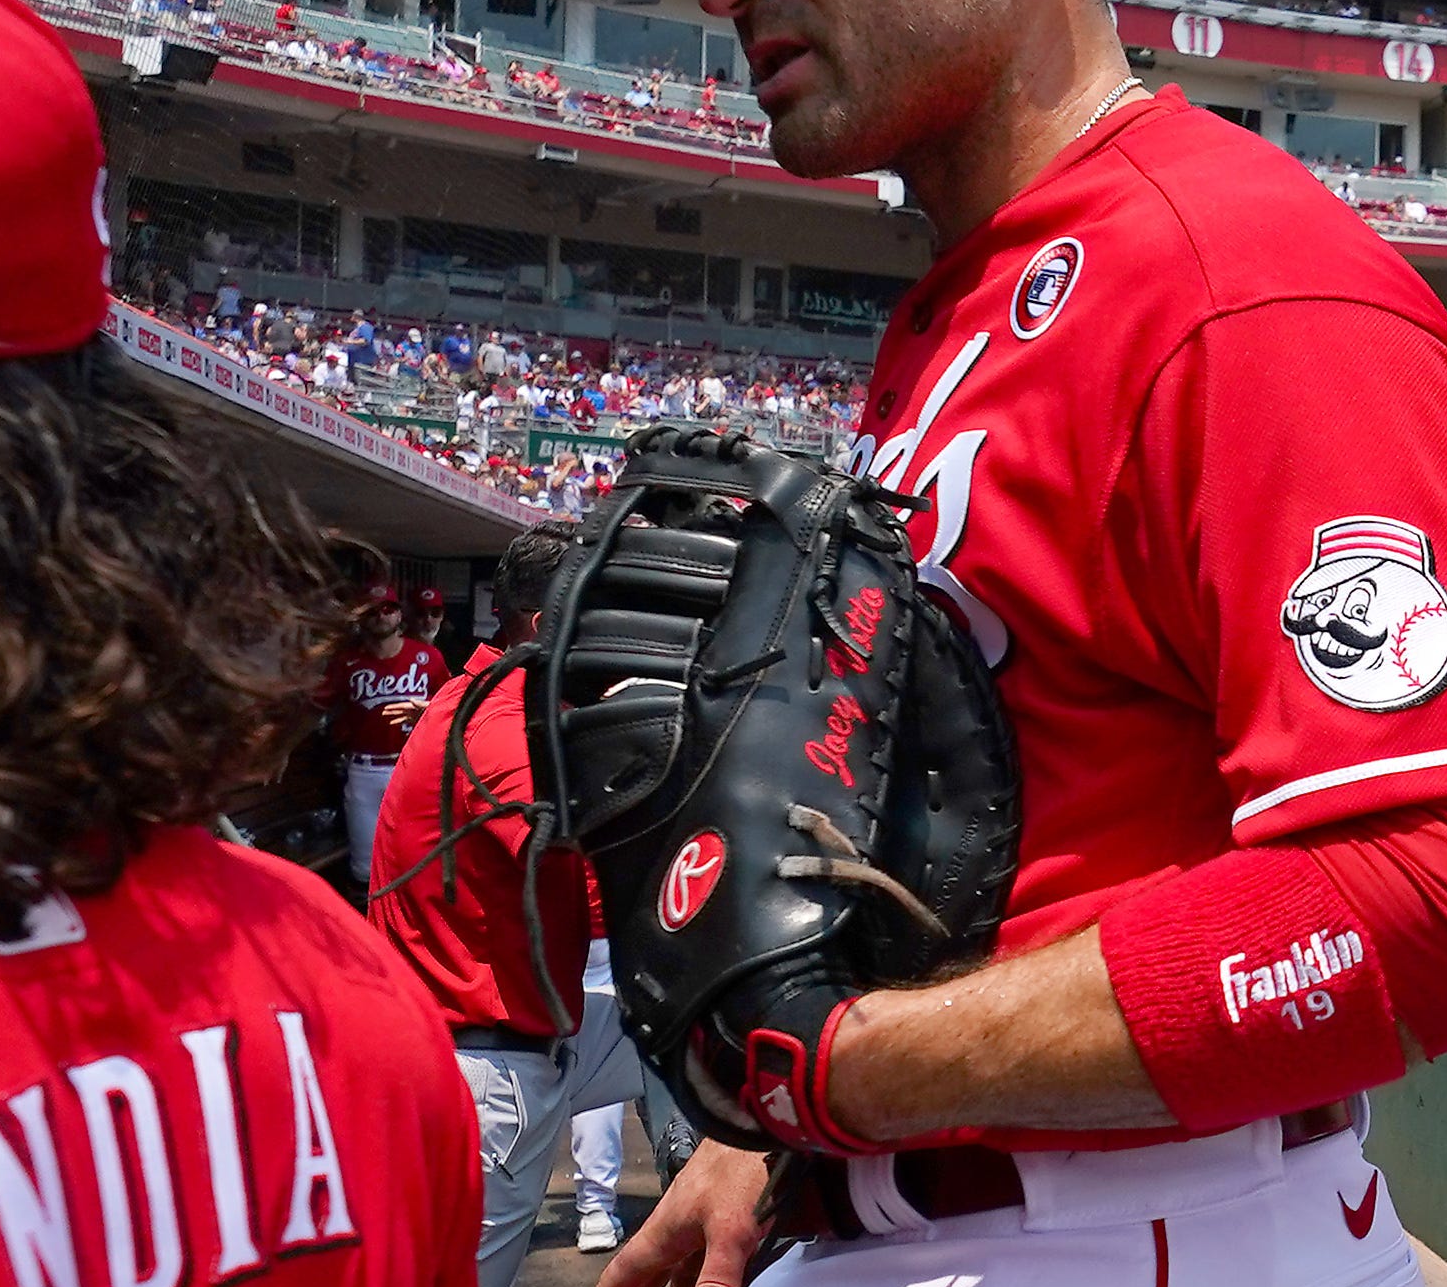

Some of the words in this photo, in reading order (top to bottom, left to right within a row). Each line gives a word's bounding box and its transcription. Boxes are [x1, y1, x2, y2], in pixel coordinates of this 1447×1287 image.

[1186, 16, 1211, 55] 11
[1394, 42, 1426, 78] 14
[349, 663, 429, 710] Reds
[804, 694, 869, 789] Joey
[1219, 928, 1364, 1024] Franklin
[1280, 990, 1335, 1030] 19
